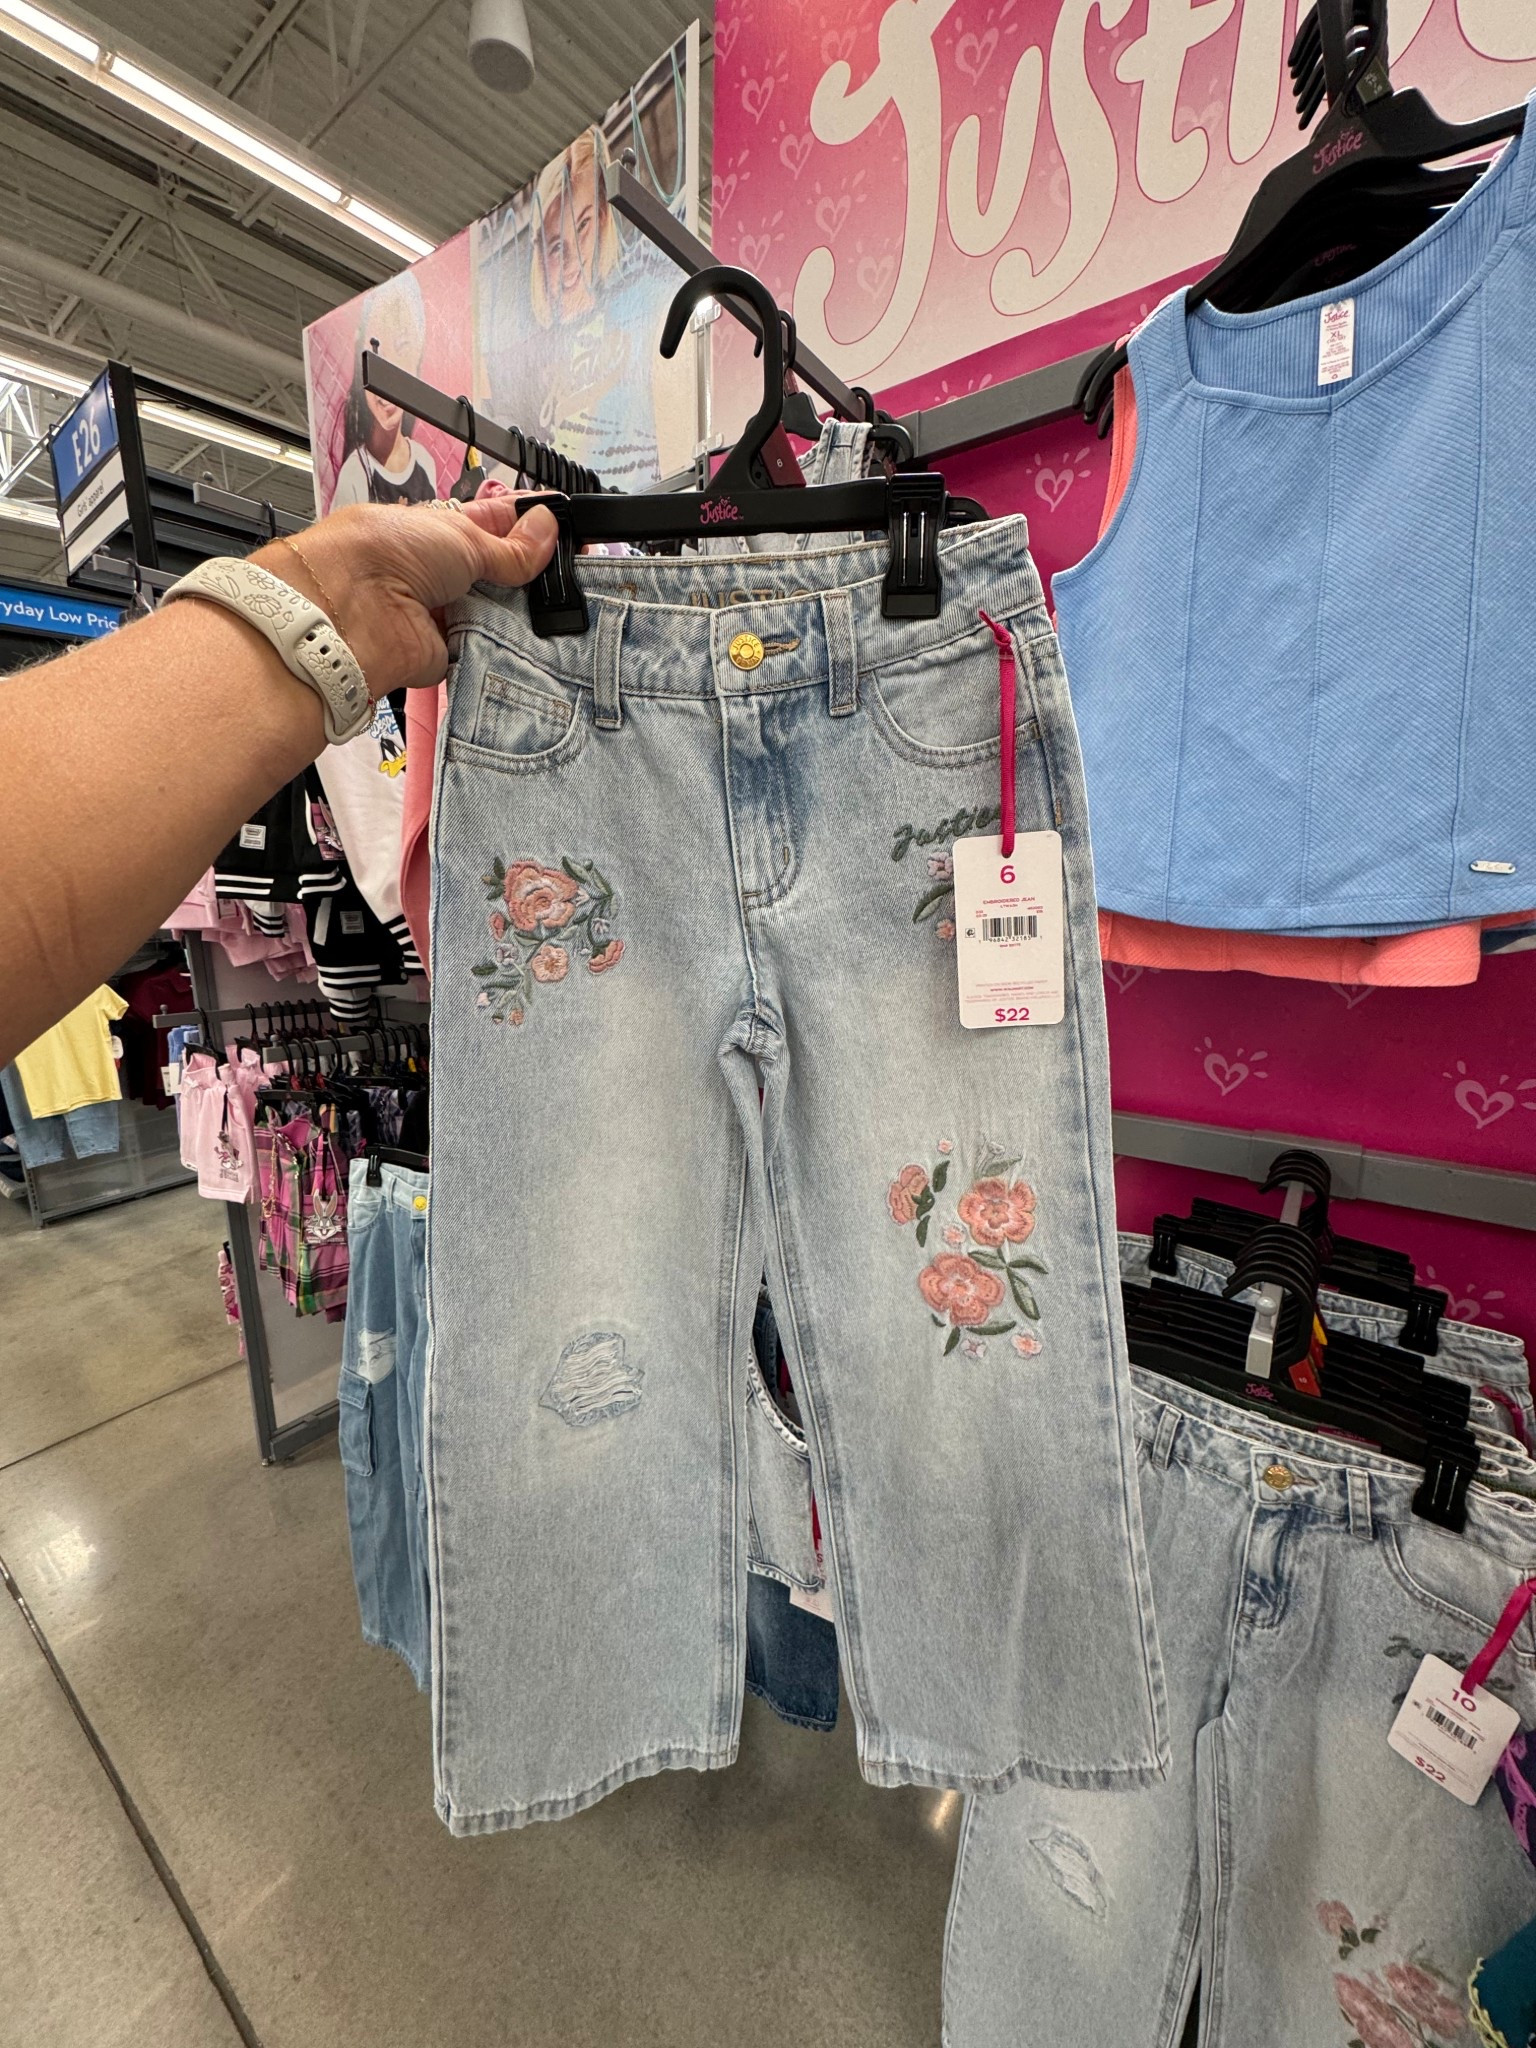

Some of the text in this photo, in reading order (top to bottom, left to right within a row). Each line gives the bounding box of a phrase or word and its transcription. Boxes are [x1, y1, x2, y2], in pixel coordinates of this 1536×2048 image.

[1312, 131, 1364, 175] Justice
[792, 0, 1536, 383] Justi
[71, 405, 101, 477] E26
[776, 458, 783, 468] 6
[700, 497, 740, 524] Justice
[0, 600, 119, 630] yday Low Pric
[1000, 865, 1016, 884] 6
[995, 1007, 1030, 1022] $22
[1452, 1688, 1477, 1712] 10
[1415, 1755, 1446, 1783] $22
